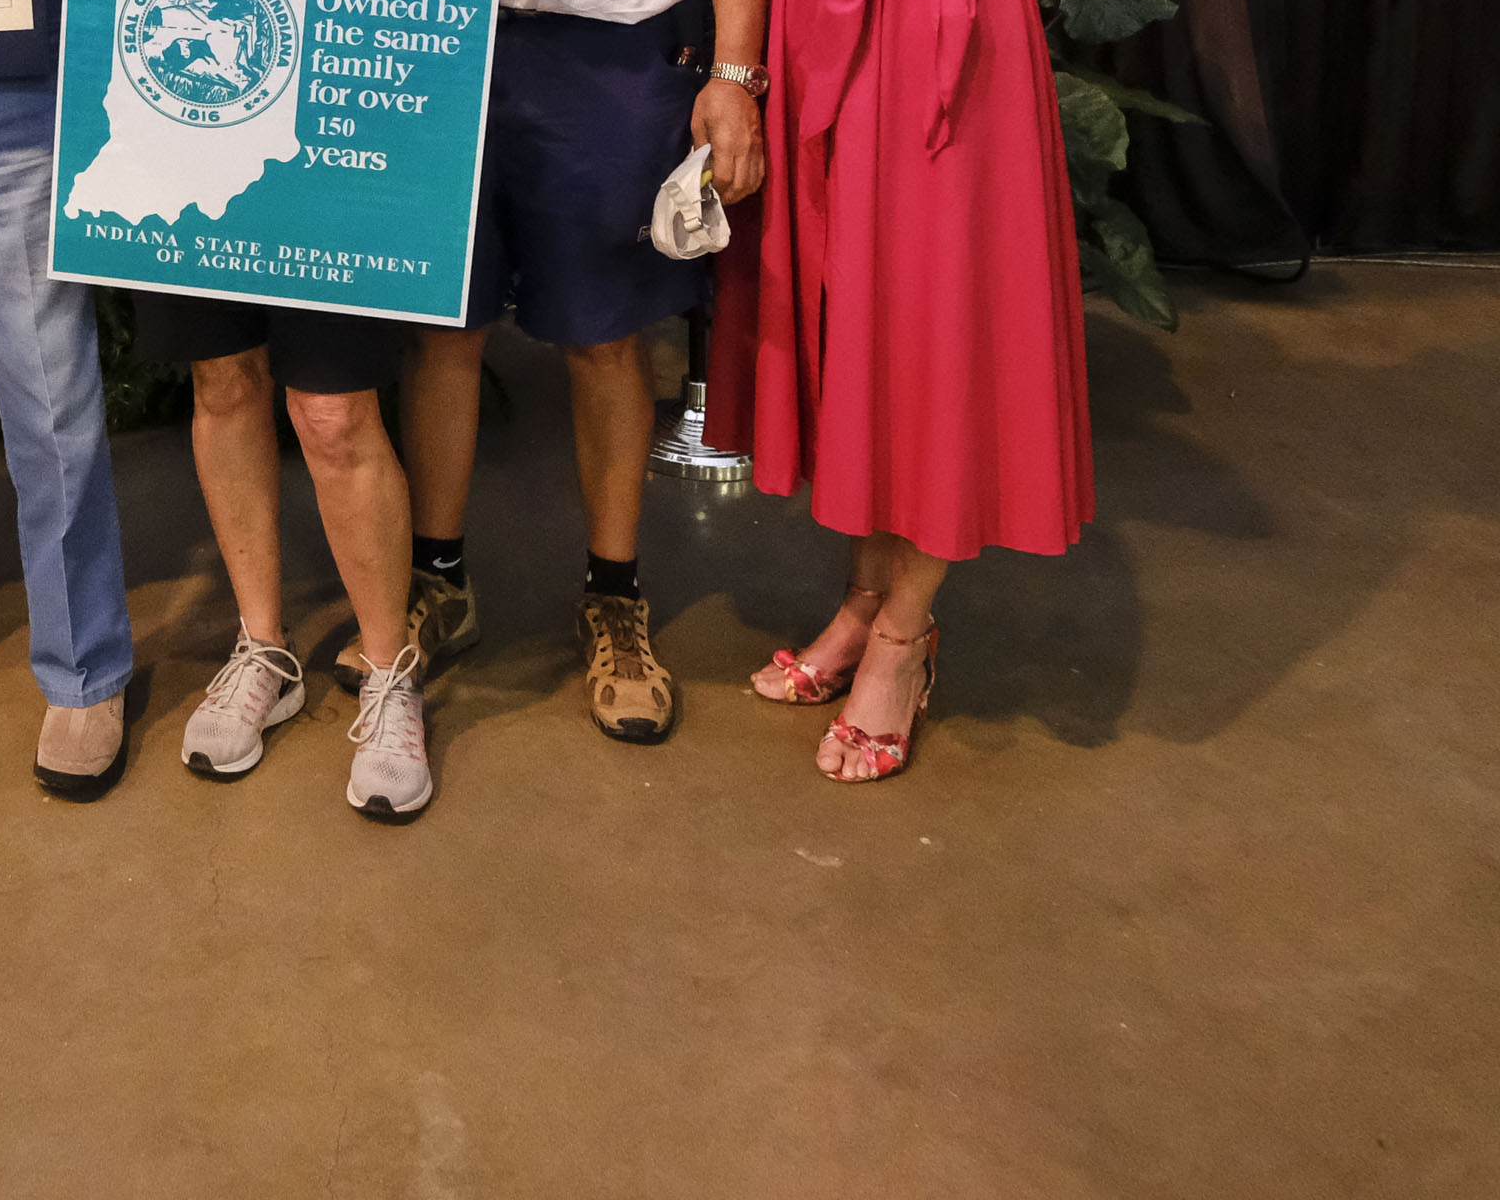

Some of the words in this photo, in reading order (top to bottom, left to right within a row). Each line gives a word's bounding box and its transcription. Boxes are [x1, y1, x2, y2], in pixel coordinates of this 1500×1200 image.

[124, 14, 140, 53] SEAL
[314, 18, 364, 46] the
[373, 29, 461, 55] same
[311, 48, 415, 86] family
[181, 107, 220, 122] 1816
[308, 79, 352, 106] for
[358, 89, 429, 114] over
[317, 116, 356, 138] 150
[304, 144, 388, 171] years
[85, 223, 179, 248] INDIANA
[194, 236, 262, 257] STATE
[278, 245, 432, 276] DEPARTMENT
[156, 248, 185, 265] OF
[197, 255, 355, 284] AGRICULTURE
